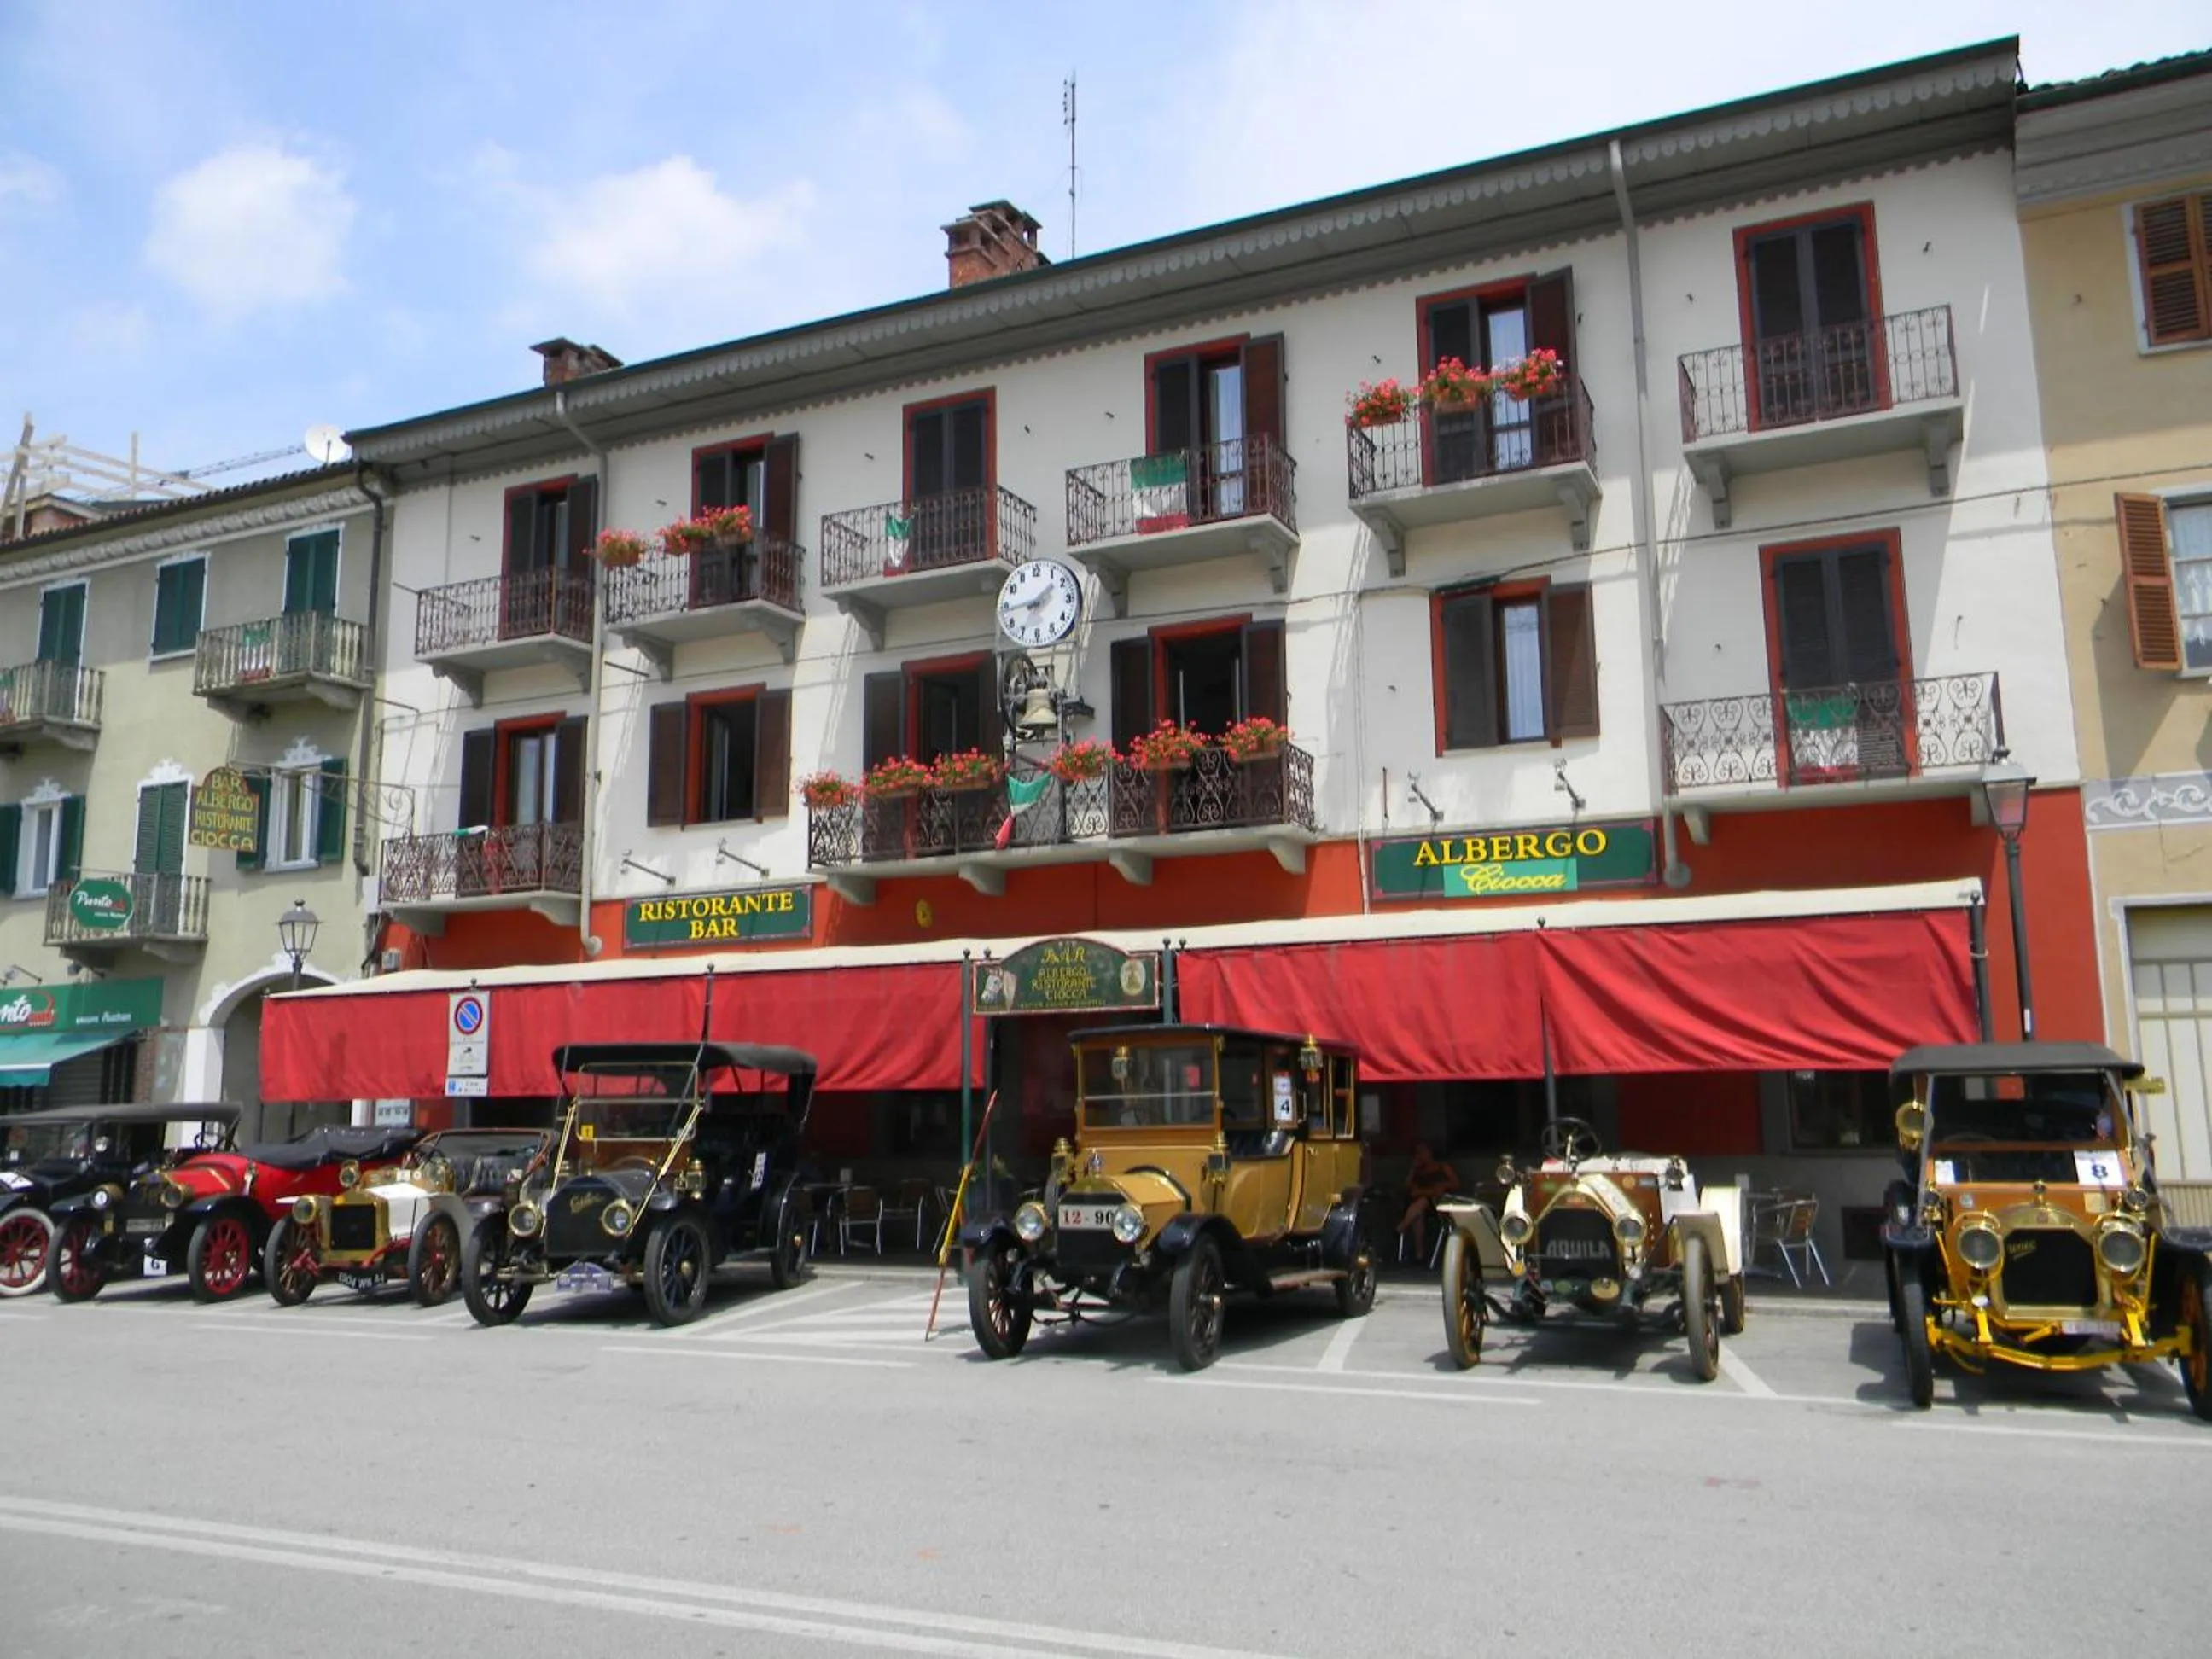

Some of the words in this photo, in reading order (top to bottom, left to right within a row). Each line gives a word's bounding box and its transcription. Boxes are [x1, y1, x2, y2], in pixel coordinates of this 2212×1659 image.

[1033, 564, 1040, 577] 12
[1010, 584, 1017, 594] 10
[1060, 577, 1066, 588] 2
[1066, 593, 1072, 604] 3
[1010, 618, 1016, 628] 8
[1060, 612, 1066, 622] 4
[1020, 626, 1026, 637] 7
[1034, 628, 1040, 639] 6
[1049, 622, 1055, 633] 5
[212, 773, 241, 791] BAR
[196, 789, 253, 812] ALBERGO
[195, 808, 253, 833] RISTORANTE
[190, 829, 253, 852] CIOCCA
[1413, 829, 1607, 867] ALBERGO
[1460, 863, 1567, 895] Ciocca
[76, 890, 113, 908] Punto
[639, 891, 794, 923] RISTORANTE
[689, 917, 739, 940] BAR
[1038, 966, 1086, 979] ALBERGO
[1032, 976, 1097, 992] RISTORANTE
[1045, 989, 1086, 1001] CIOCCA
[1280, 1098, 1289, 1115] 4
[2092, 1164, 2108, 1179] 8
[1546, 1239, 1611, 1259] AQUILA
[151, 1259, 160, 1271] 6
